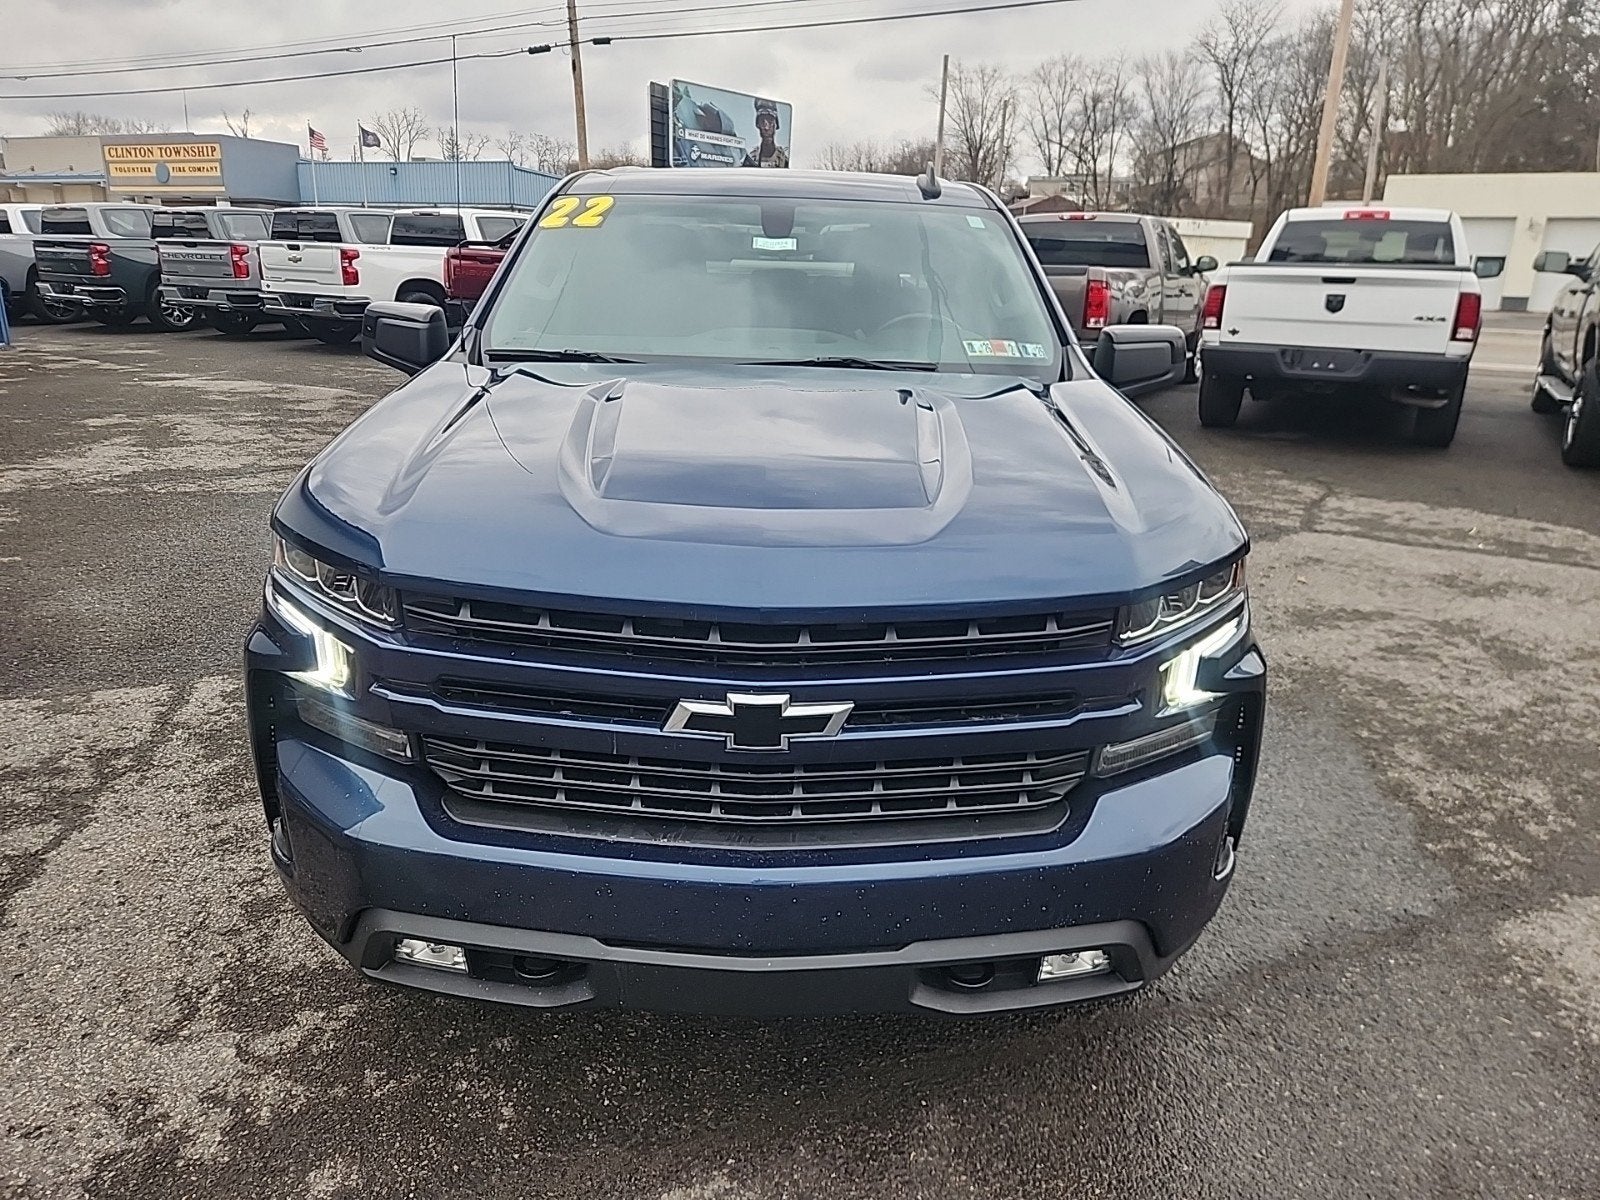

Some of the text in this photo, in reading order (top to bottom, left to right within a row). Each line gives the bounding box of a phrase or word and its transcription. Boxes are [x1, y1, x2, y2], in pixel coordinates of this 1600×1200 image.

[108, 145, 217, 158] CLINTON TOWNSHIP
[700, 152, 734, 163] MARINES
[538, 196, 615, 229] 22
[162, 252, 225, 260] CHEVROLET
